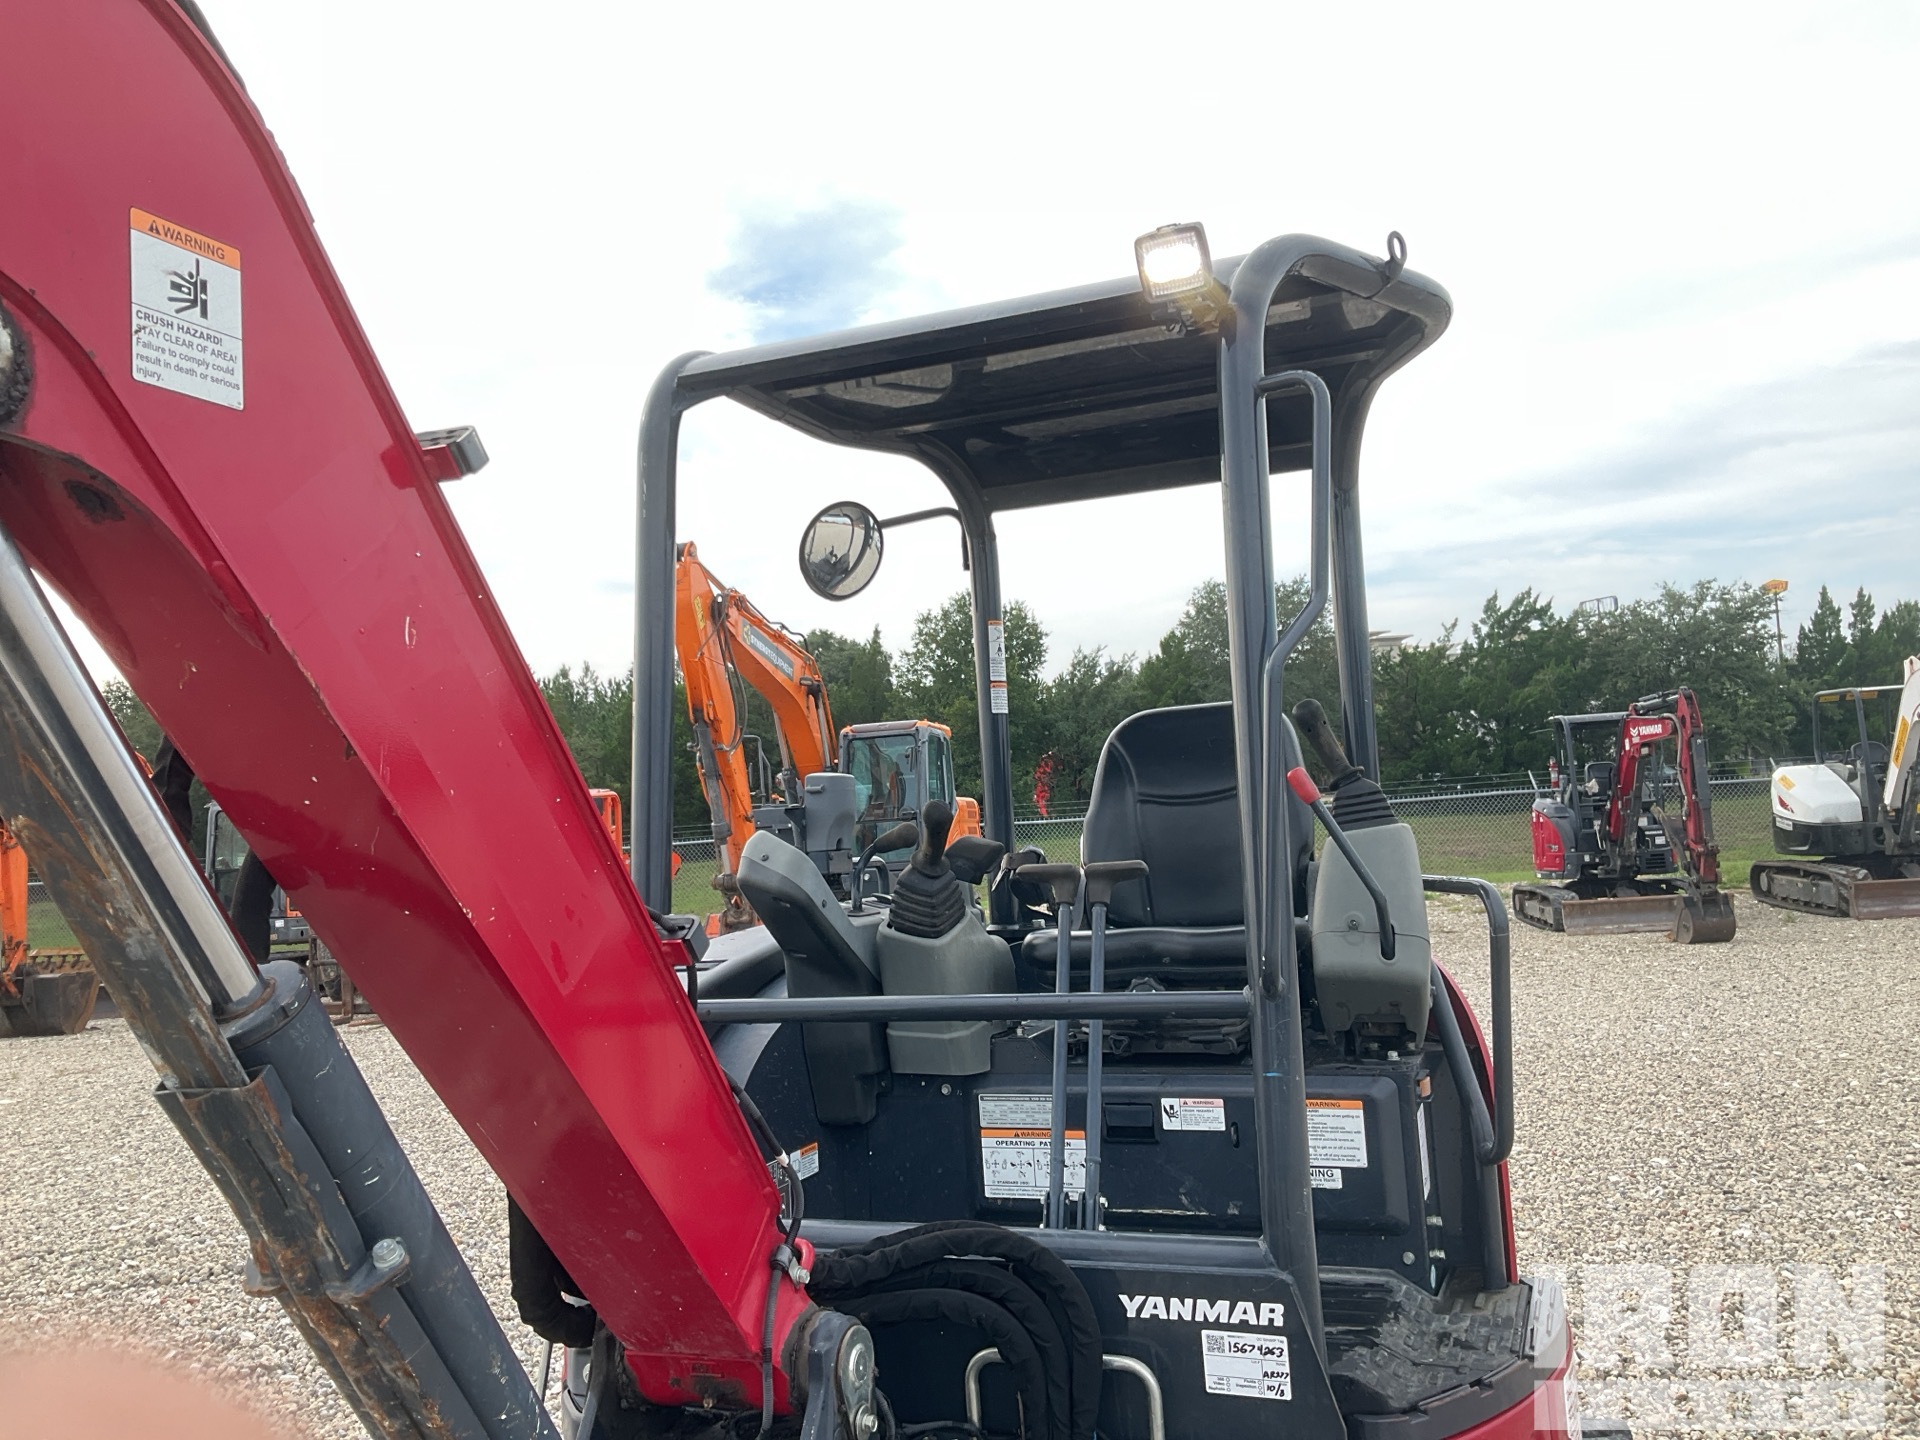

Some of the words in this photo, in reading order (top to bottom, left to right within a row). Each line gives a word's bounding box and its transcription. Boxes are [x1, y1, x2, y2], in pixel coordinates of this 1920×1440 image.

[162, 224, 225, 260] WARNING
[136, 310, 174, 330] CRUSH
[177, 323, 223, 347] HAZARD!
[136, 323, 160, 339] STAY
[163, 332, 194, 351] CLEAR
[196, 343, 209, 354] OF
[210, 348, 238, 364] AREA!
[136, 337, 167, 355] Failure
[168, 348, 177, 358] to
[179, 352, 210, 370] comply
[212, 363, 235, 376] could
[136, 352, 162, 367] result
[164, 359, 172, 370] in
[174, 363, 198, 378] death
[200, 372, 209, 380] or
[210, 374, 241, 391] serious
[136, 364, 165, 382] injury.
[1638, 723, 1663, 736] YANMAR
[1118, 1294, 1285, 1327] YANMAR
